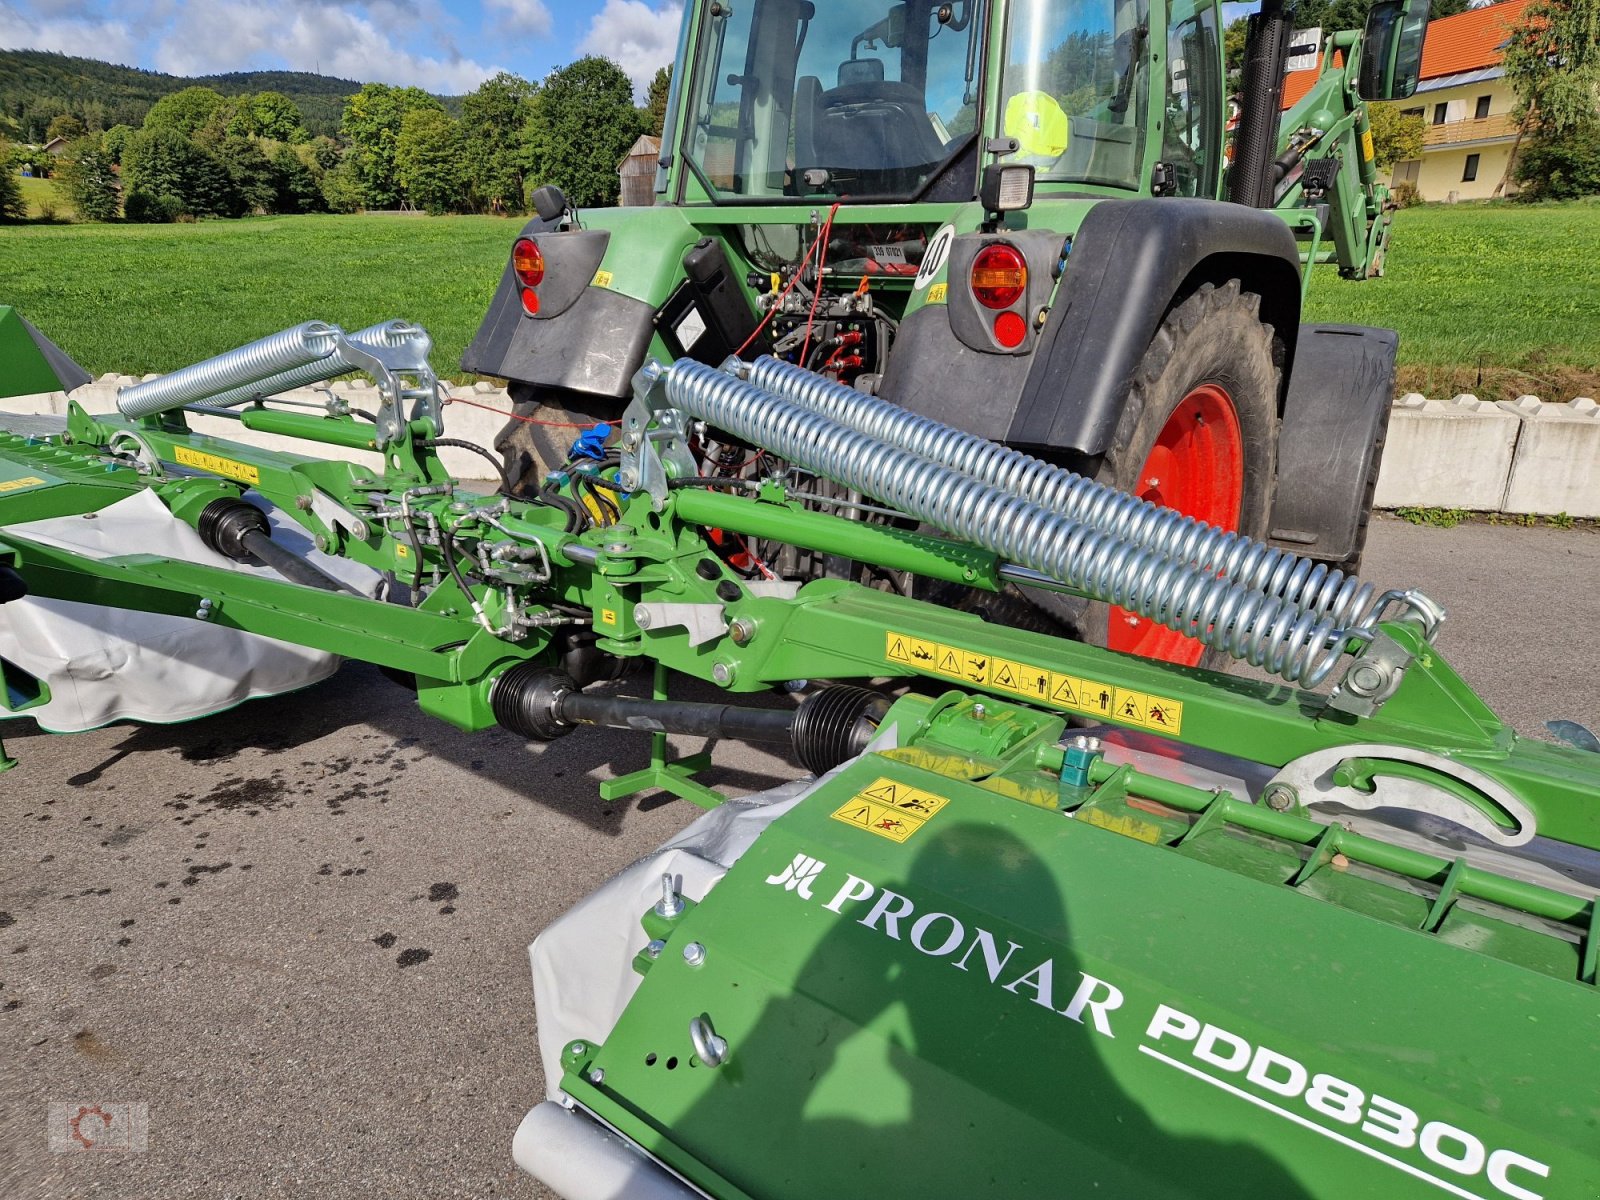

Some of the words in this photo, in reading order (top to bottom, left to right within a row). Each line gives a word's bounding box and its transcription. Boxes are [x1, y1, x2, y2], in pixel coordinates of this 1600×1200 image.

[919, 232, 950, 279] 40
[821, 872, 1125, 1039] PRONAR
[1145, 1003, 1551, 1200] PDD830C
